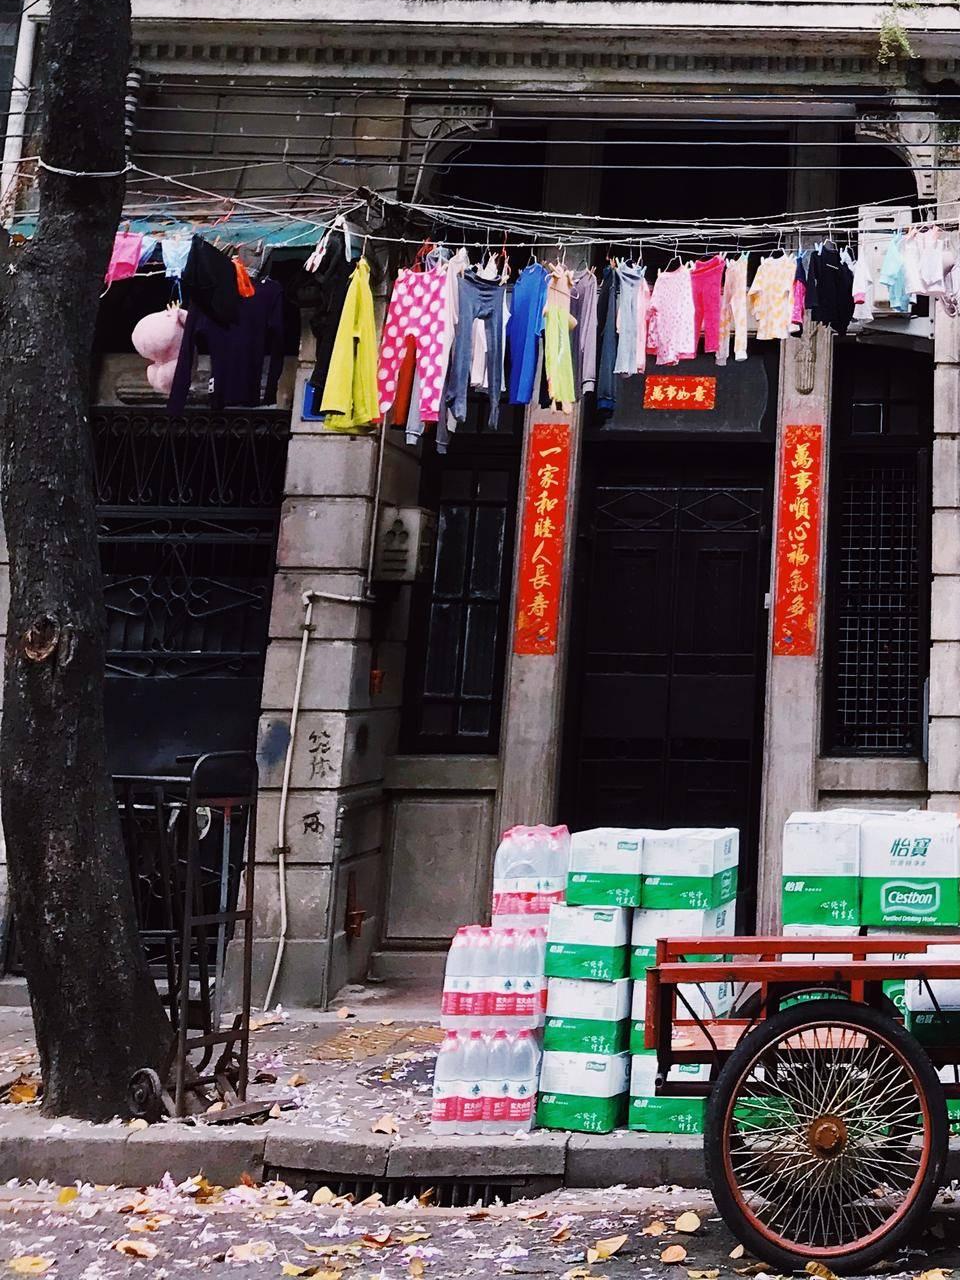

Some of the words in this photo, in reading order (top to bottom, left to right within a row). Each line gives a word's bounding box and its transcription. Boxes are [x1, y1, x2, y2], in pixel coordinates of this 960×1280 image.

[650, 384, 707, 401] 萬事如意
[890, 837, 931, 857] 怡寶
